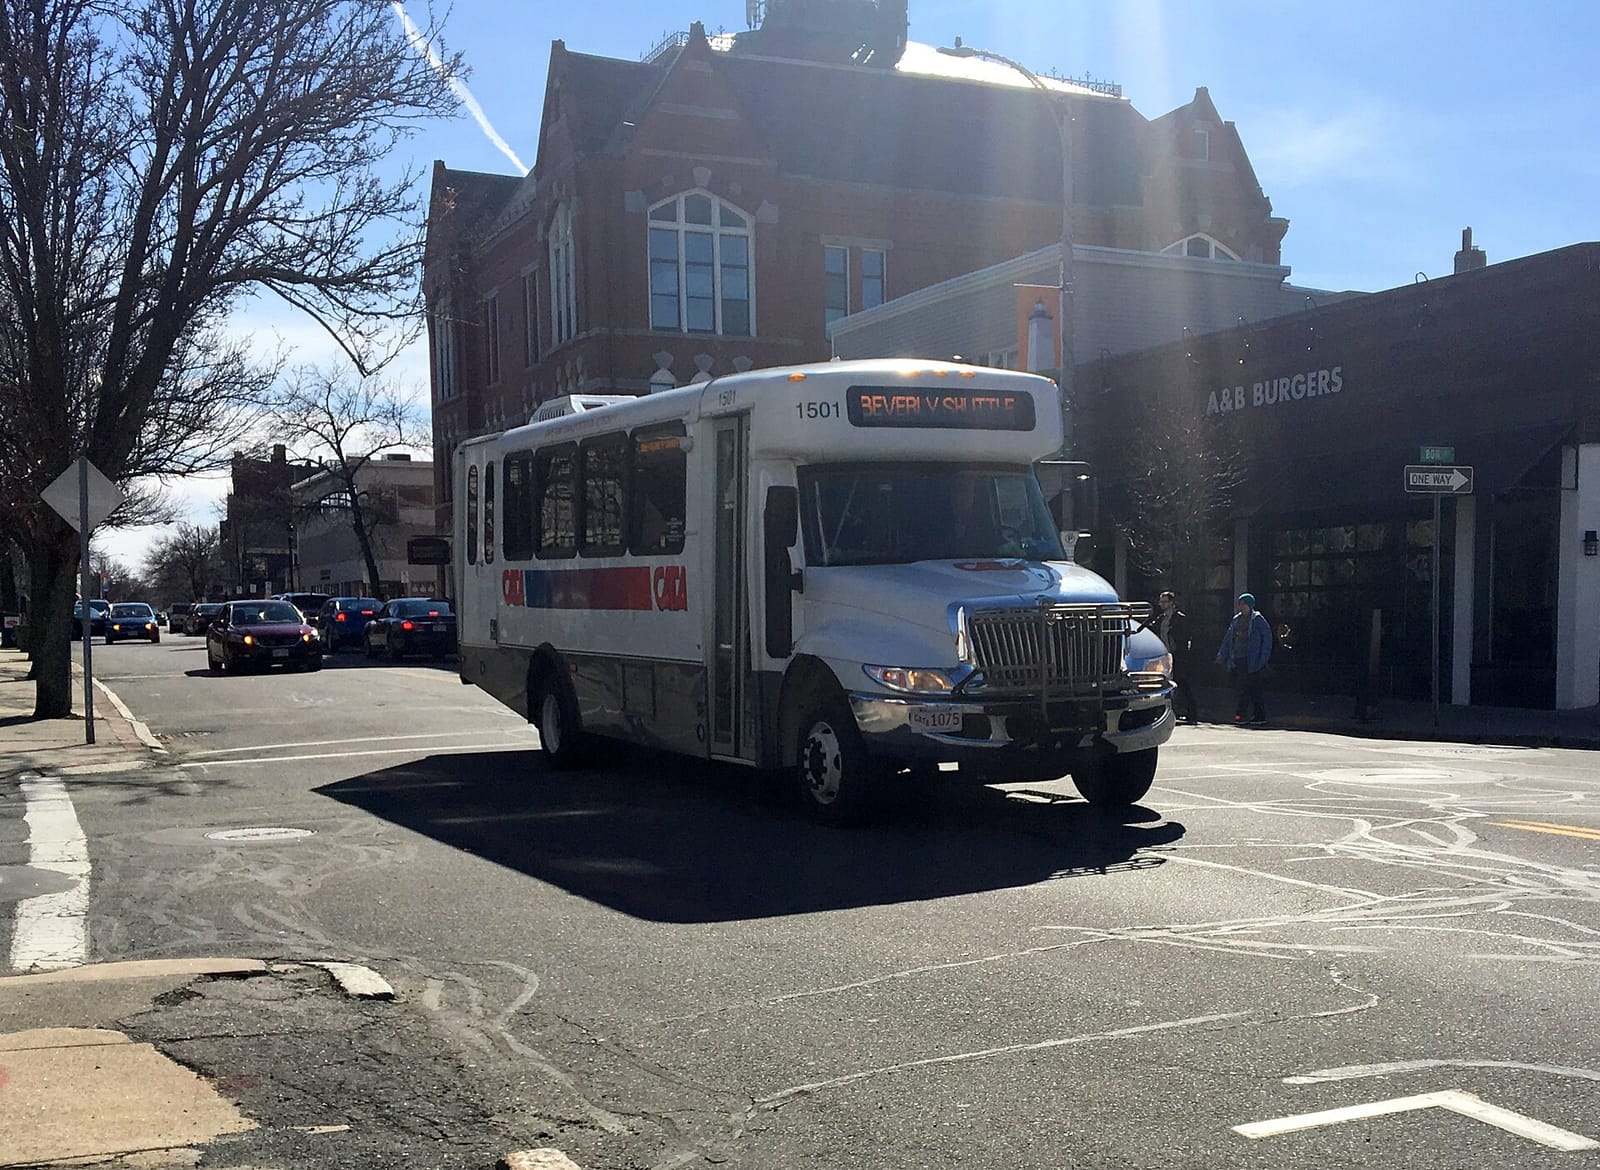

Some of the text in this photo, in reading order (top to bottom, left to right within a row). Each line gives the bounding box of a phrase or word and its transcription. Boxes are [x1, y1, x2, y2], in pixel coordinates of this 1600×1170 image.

[719, 389, 736, 407] 1501
[1206, 366, 1343, 416] A&B BURGERS
[796, 401, 840, 419] 1501
[1411, 474, 1452, 485] ONE WAY
[931, 712, 960, 727] 1075
